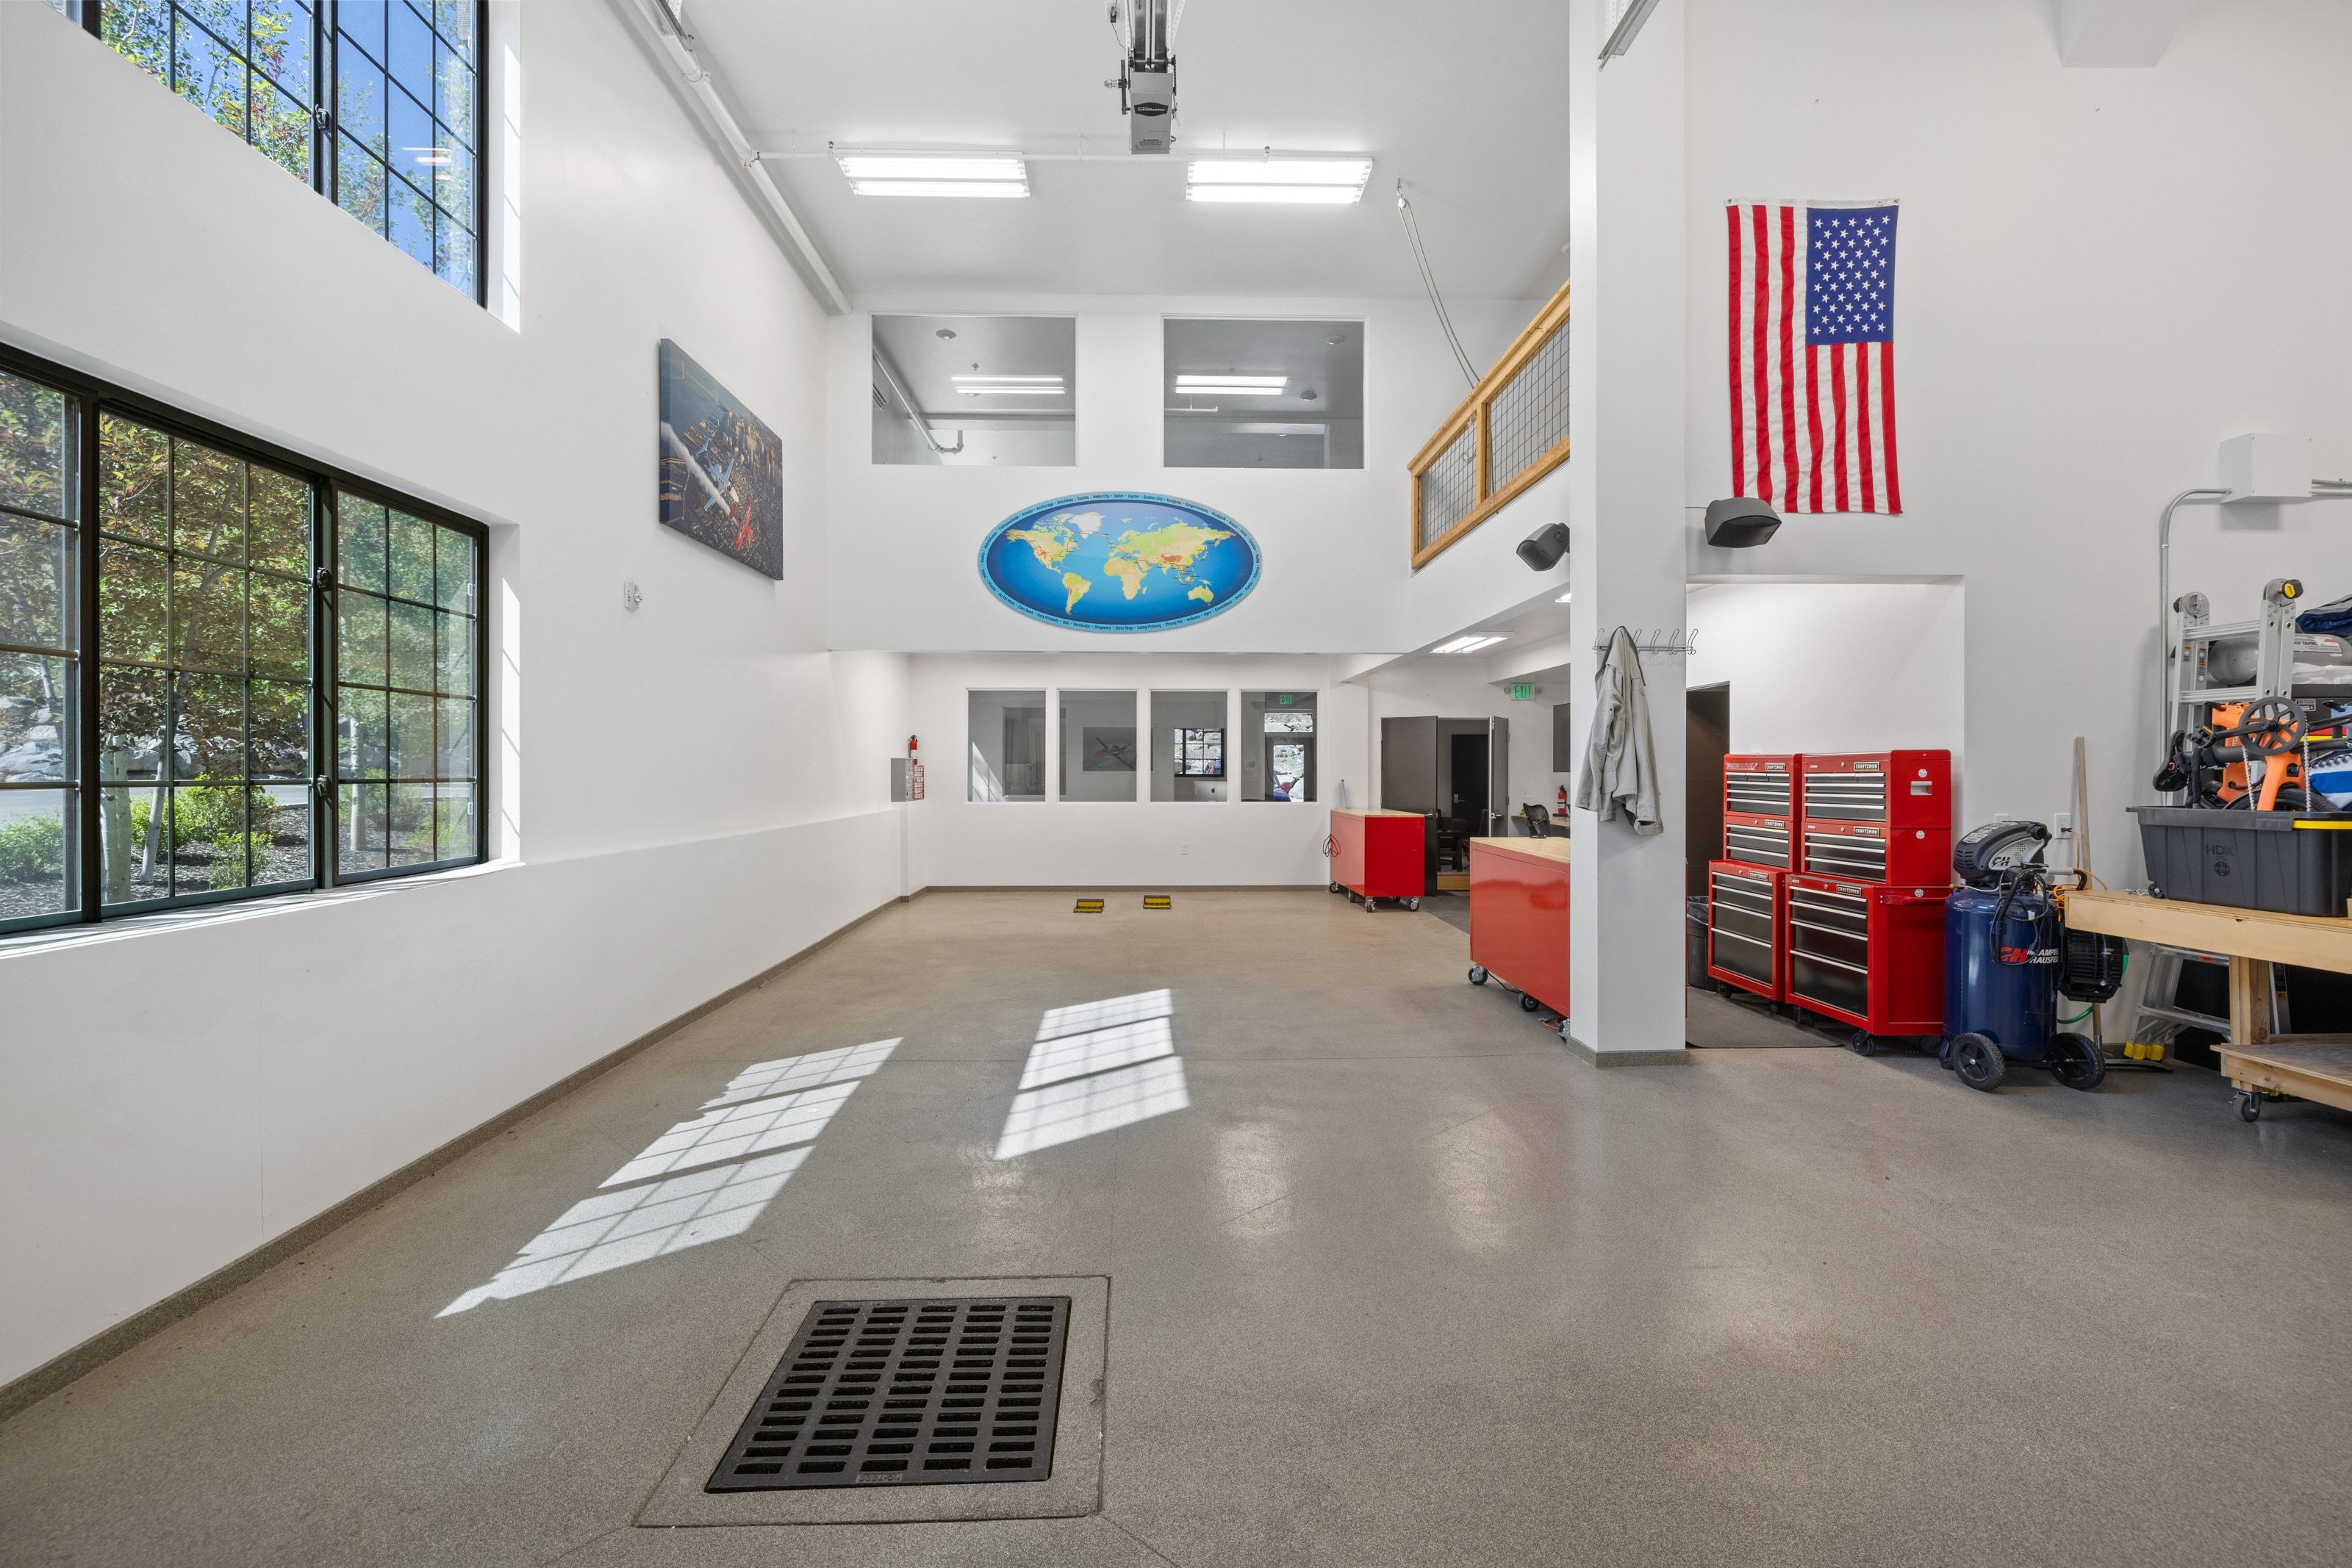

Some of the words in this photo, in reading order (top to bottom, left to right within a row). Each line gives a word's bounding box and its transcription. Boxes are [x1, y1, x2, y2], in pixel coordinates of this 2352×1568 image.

[1036, 502, 1053, 511] Anchorage
[1514, 685, 1532, 699] EXIT
[1280, 694, 1293, 705] EXIT
[2206, 844, 2235, 855] HDX
[1749, 872, 1767, 880] CRAFTSMAN
[1838, 886, 1860, 895] CRAFTSMAN
